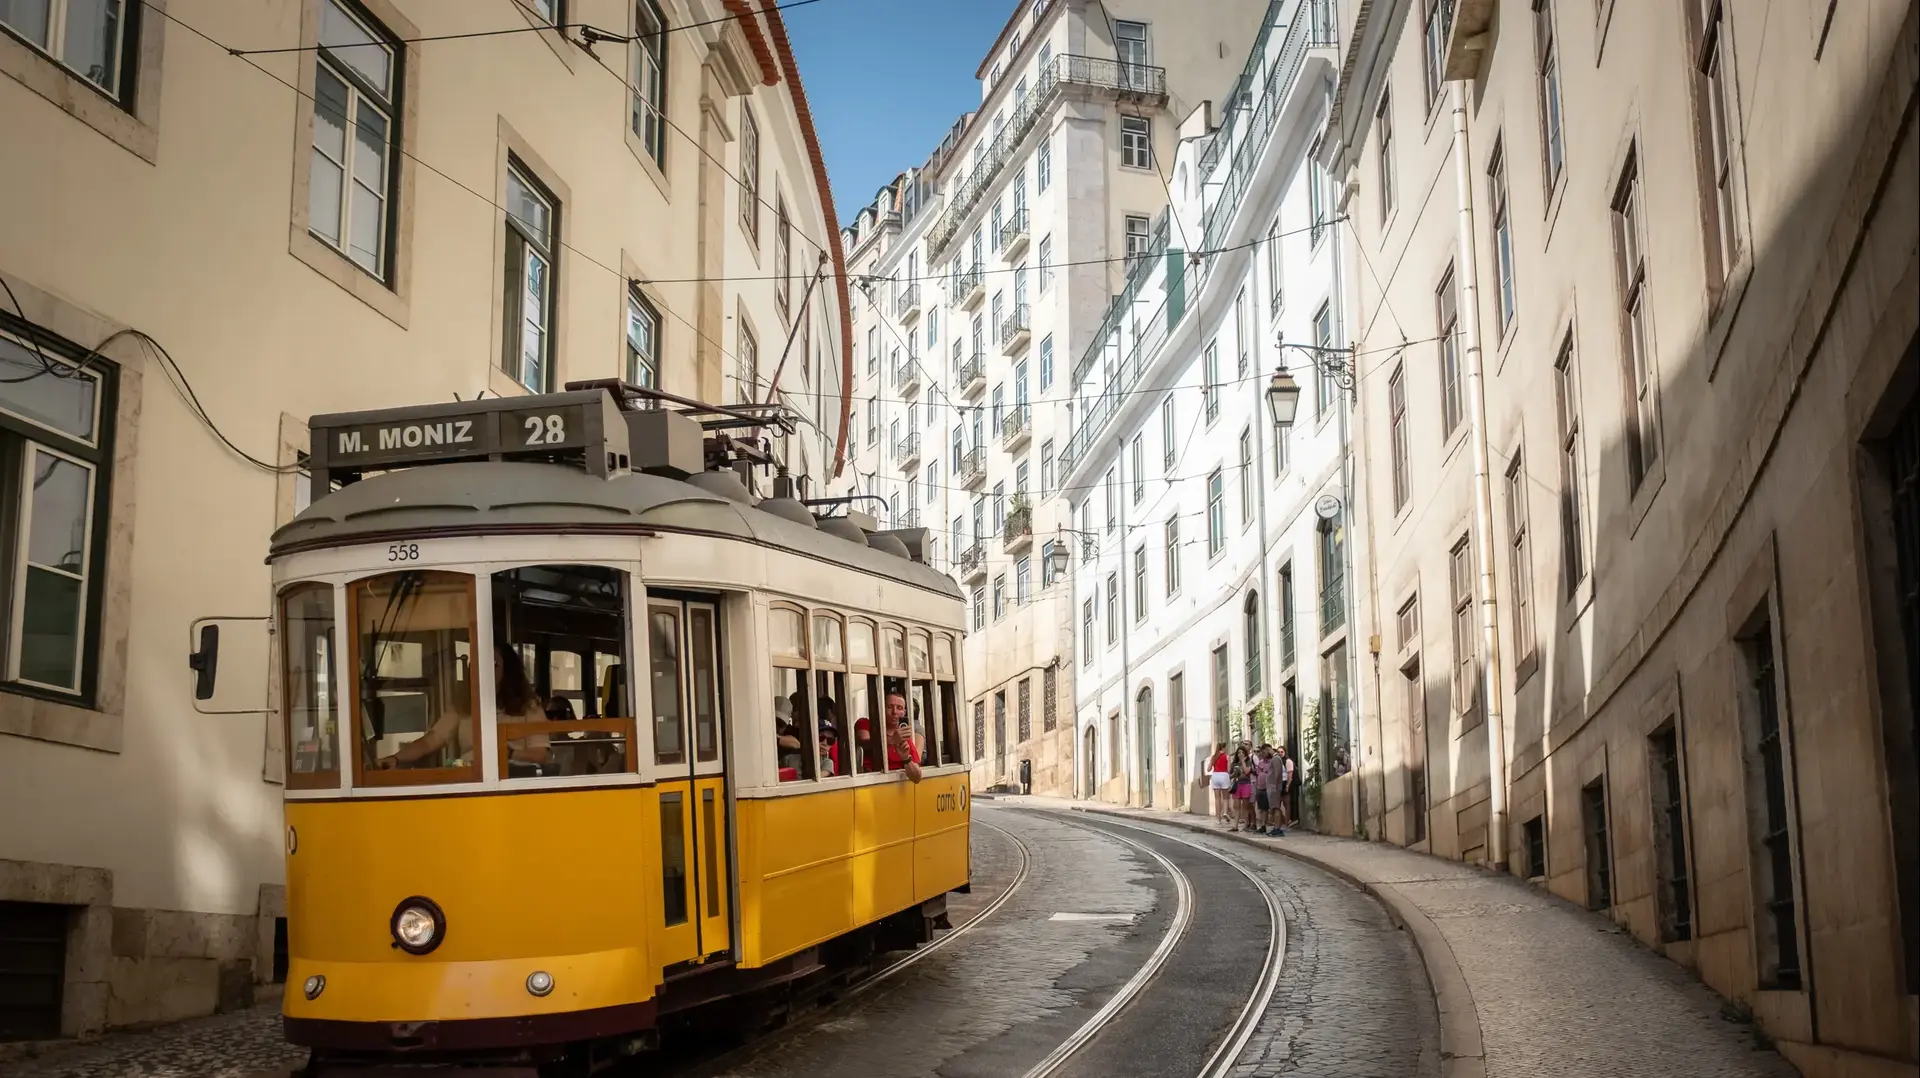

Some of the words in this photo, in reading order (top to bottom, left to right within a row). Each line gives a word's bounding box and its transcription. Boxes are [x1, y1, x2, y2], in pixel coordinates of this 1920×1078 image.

[339, 433, 369, 454] M.
[379, 421, 473, 450] MONIZ
[524, 414, 565, 445] 28
[388, 543, 420, 561] 558
[936, 785, 956, 812] carris
